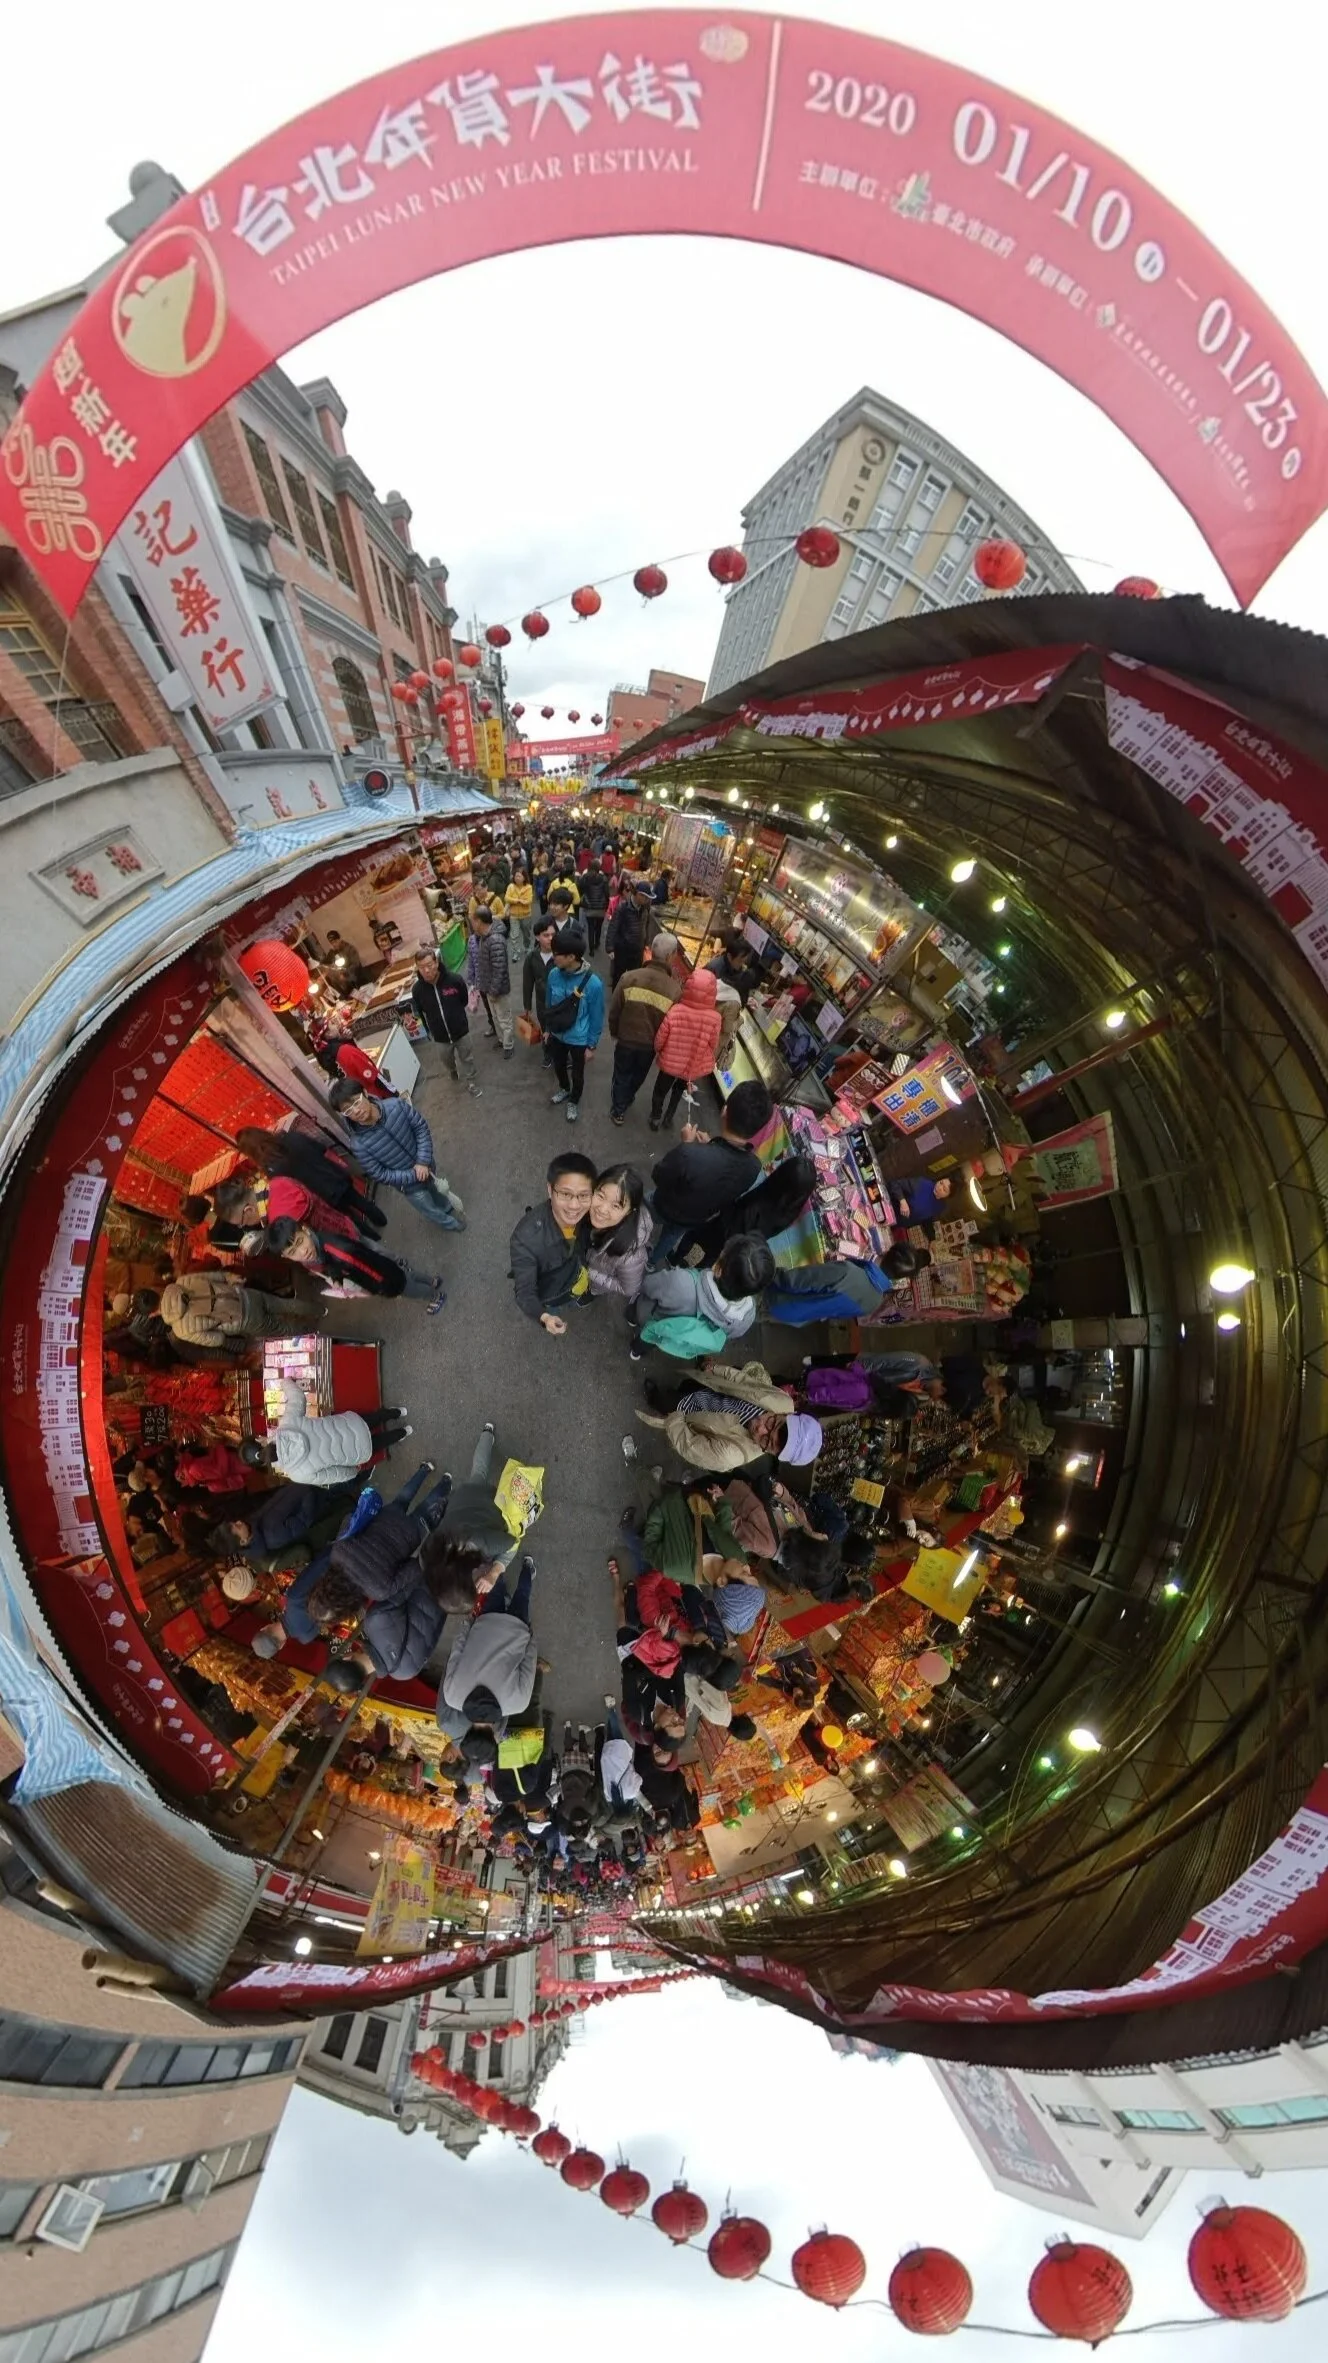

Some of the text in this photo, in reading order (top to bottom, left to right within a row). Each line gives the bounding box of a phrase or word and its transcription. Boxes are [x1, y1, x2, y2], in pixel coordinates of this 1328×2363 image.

[269, 147, 699, 285] TAIPEI LUNAR NEW YEAR FESTIVAL
[804, 69, 1132, 251] 2020 01/10
[1198, 297, 1298, 450] 01/23
[134, 499, 247, 698] 記藥行
[882, 1089, 922, 1129] 出清
